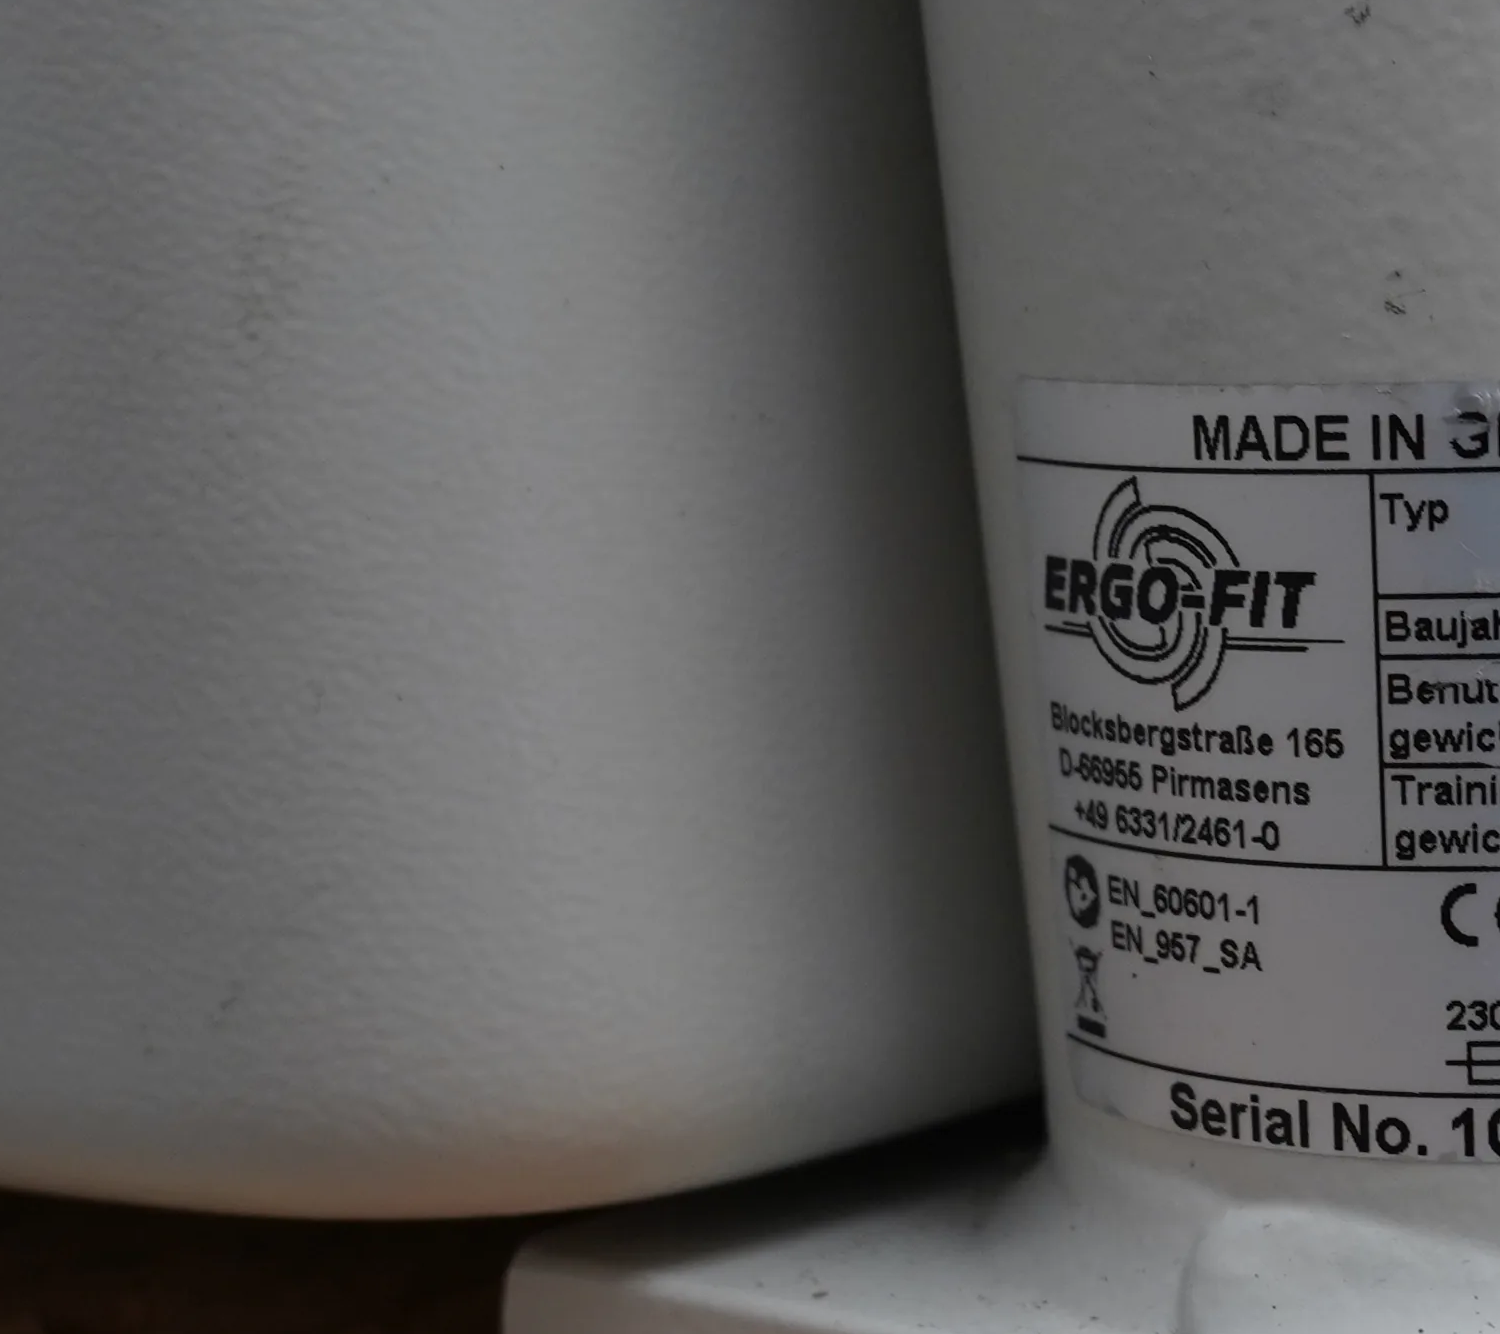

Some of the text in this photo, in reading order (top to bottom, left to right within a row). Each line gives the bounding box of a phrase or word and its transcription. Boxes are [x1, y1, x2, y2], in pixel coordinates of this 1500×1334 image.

[1193, 414, 1349, 461] MADE
[1372, 413, 1425, 460] IN
[1379, 493, 1449, 532] Typ
[1045, 555, 1317, 628] ERGO-FIT
[1051, 701, 1344, 759] Blocksbergstraße 165
[1059, 747, 1311, 805] D-66955 Pirmasens
[1075, 800, 1280, 851] +49 6331/2461-0
[1108, 875, 1259, 924] EN_60601-1
[1170, 1082, 1309, 1148] Serial
[1333, 1103, 1428, 1156] No.
